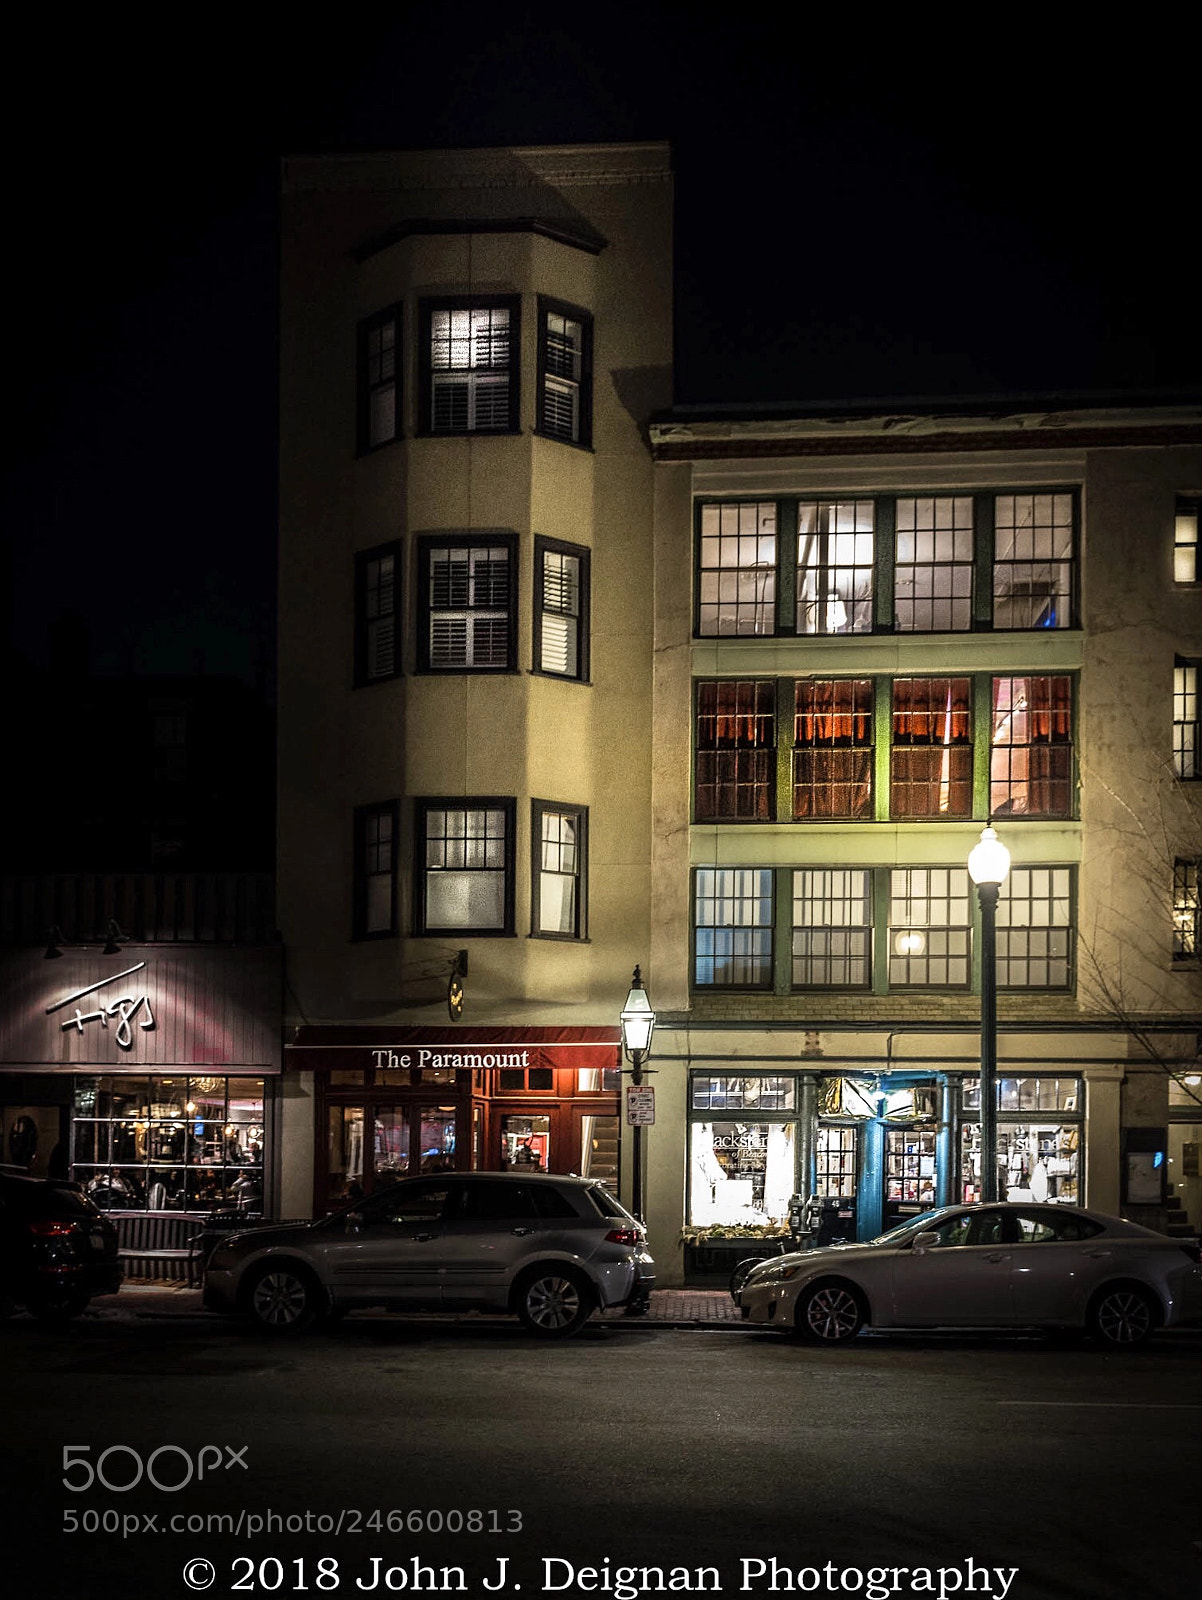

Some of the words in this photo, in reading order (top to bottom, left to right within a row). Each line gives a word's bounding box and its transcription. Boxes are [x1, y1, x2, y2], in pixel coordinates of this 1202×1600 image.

[372, 1050, 411, 1069] The
[417, 1049, 530, 1069] Paramount
[742, 1149, 768, 1158] Beaco
